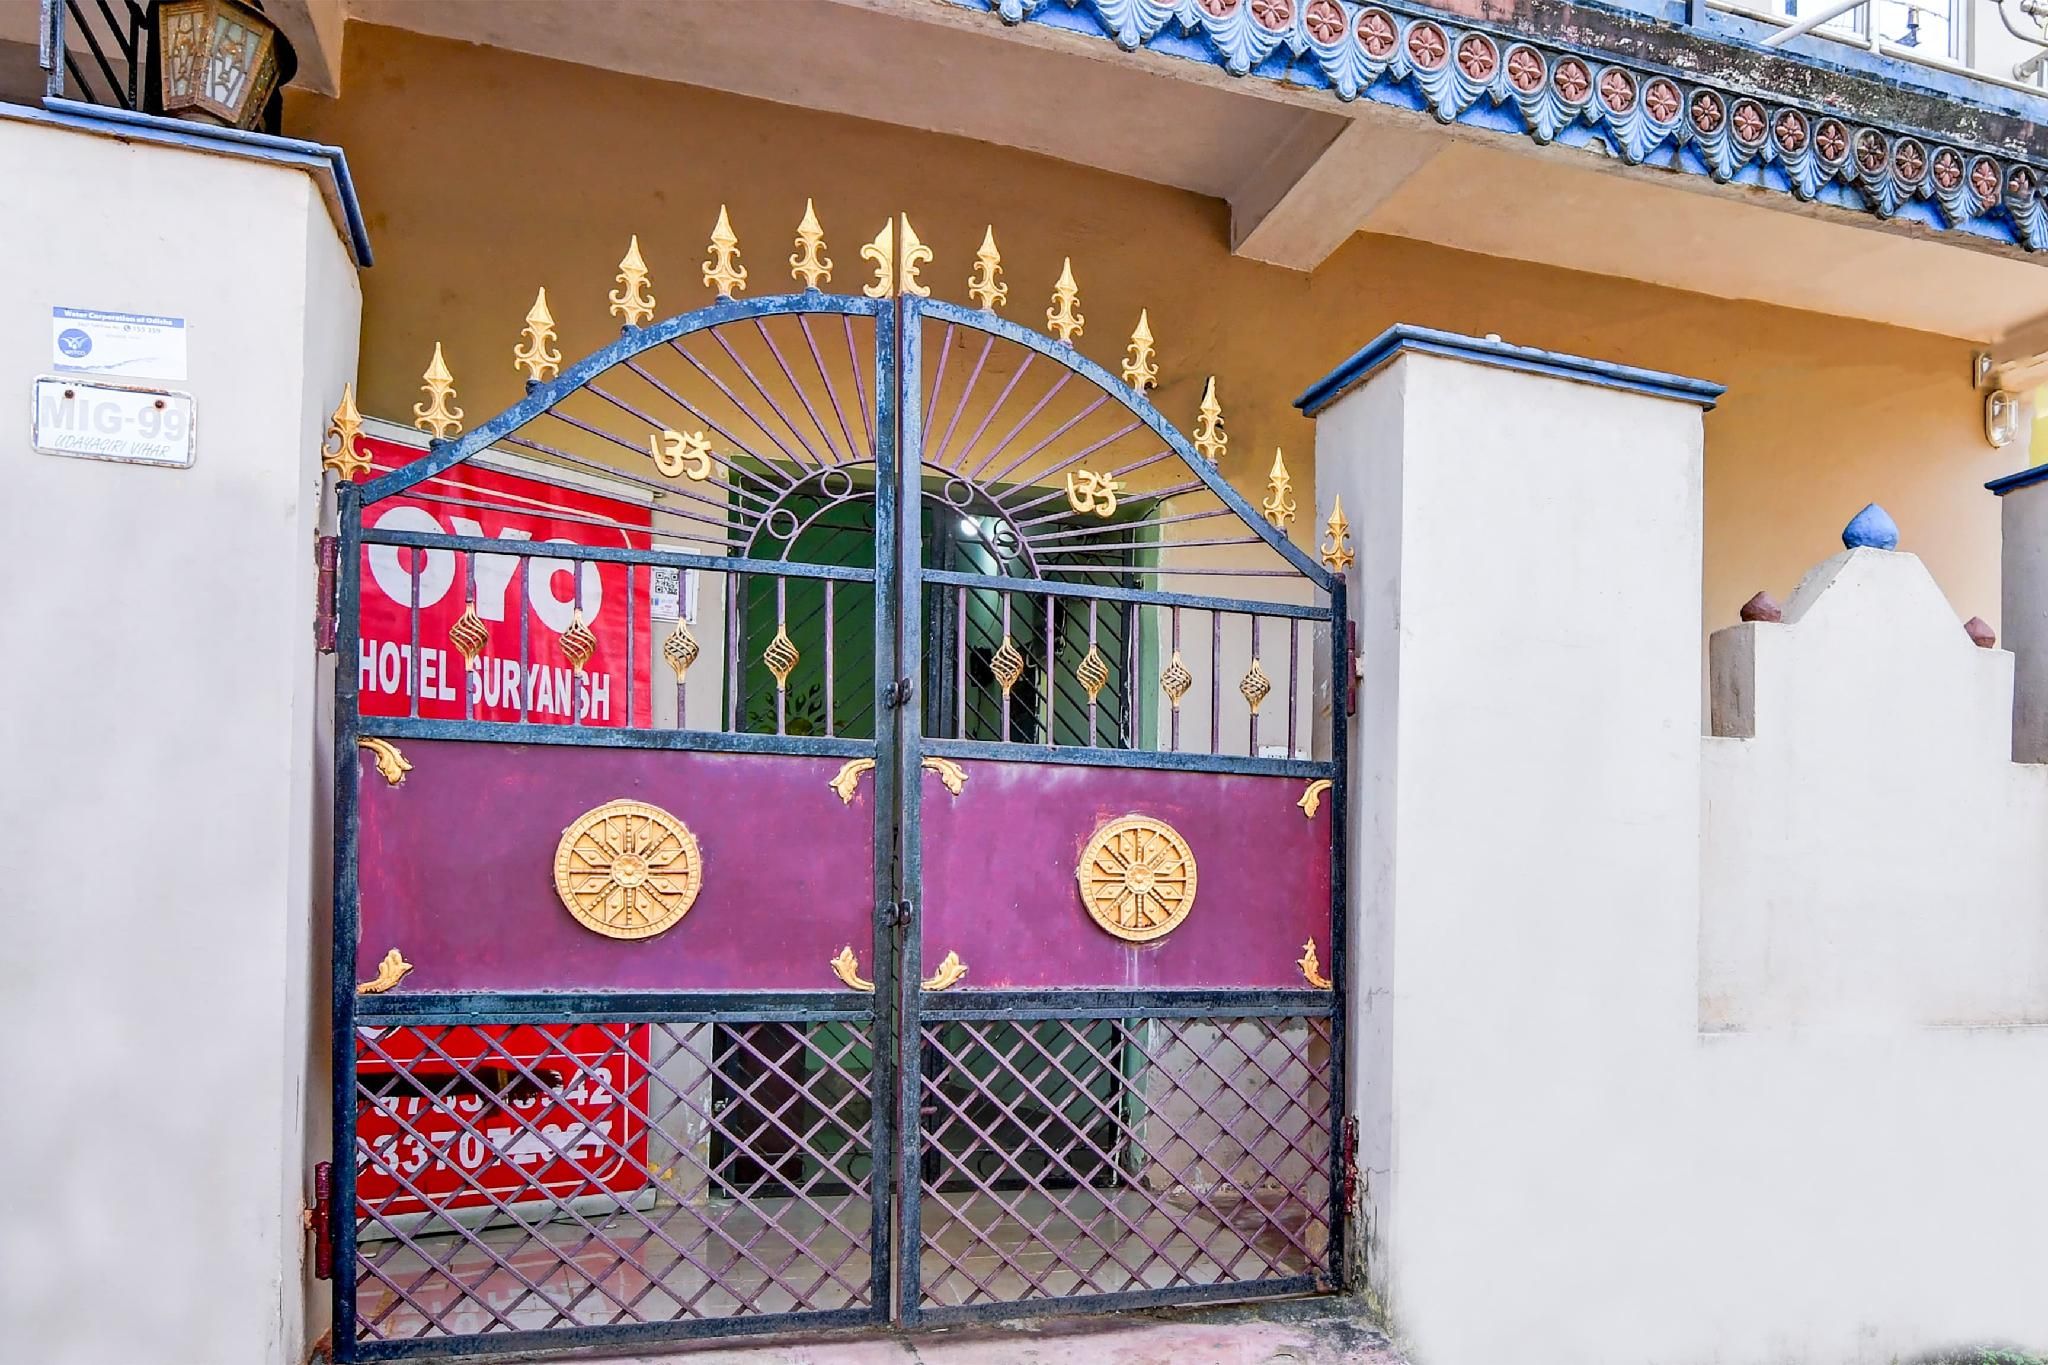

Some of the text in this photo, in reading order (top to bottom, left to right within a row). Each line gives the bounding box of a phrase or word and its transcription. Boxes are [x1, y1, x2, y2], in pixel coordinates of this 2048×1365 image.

[64, 309, 87, 318] Water
[88, 311, 135, 322] Corporation
[146, 317, 173, 326] Odisha
[41, 395, 186, 442] MIG-99
[130, 441, 171, 458] VIHAR
[368, 506, 603, 634] OYO
[358, 637, 610, 721] HOTEL SURYANSH
